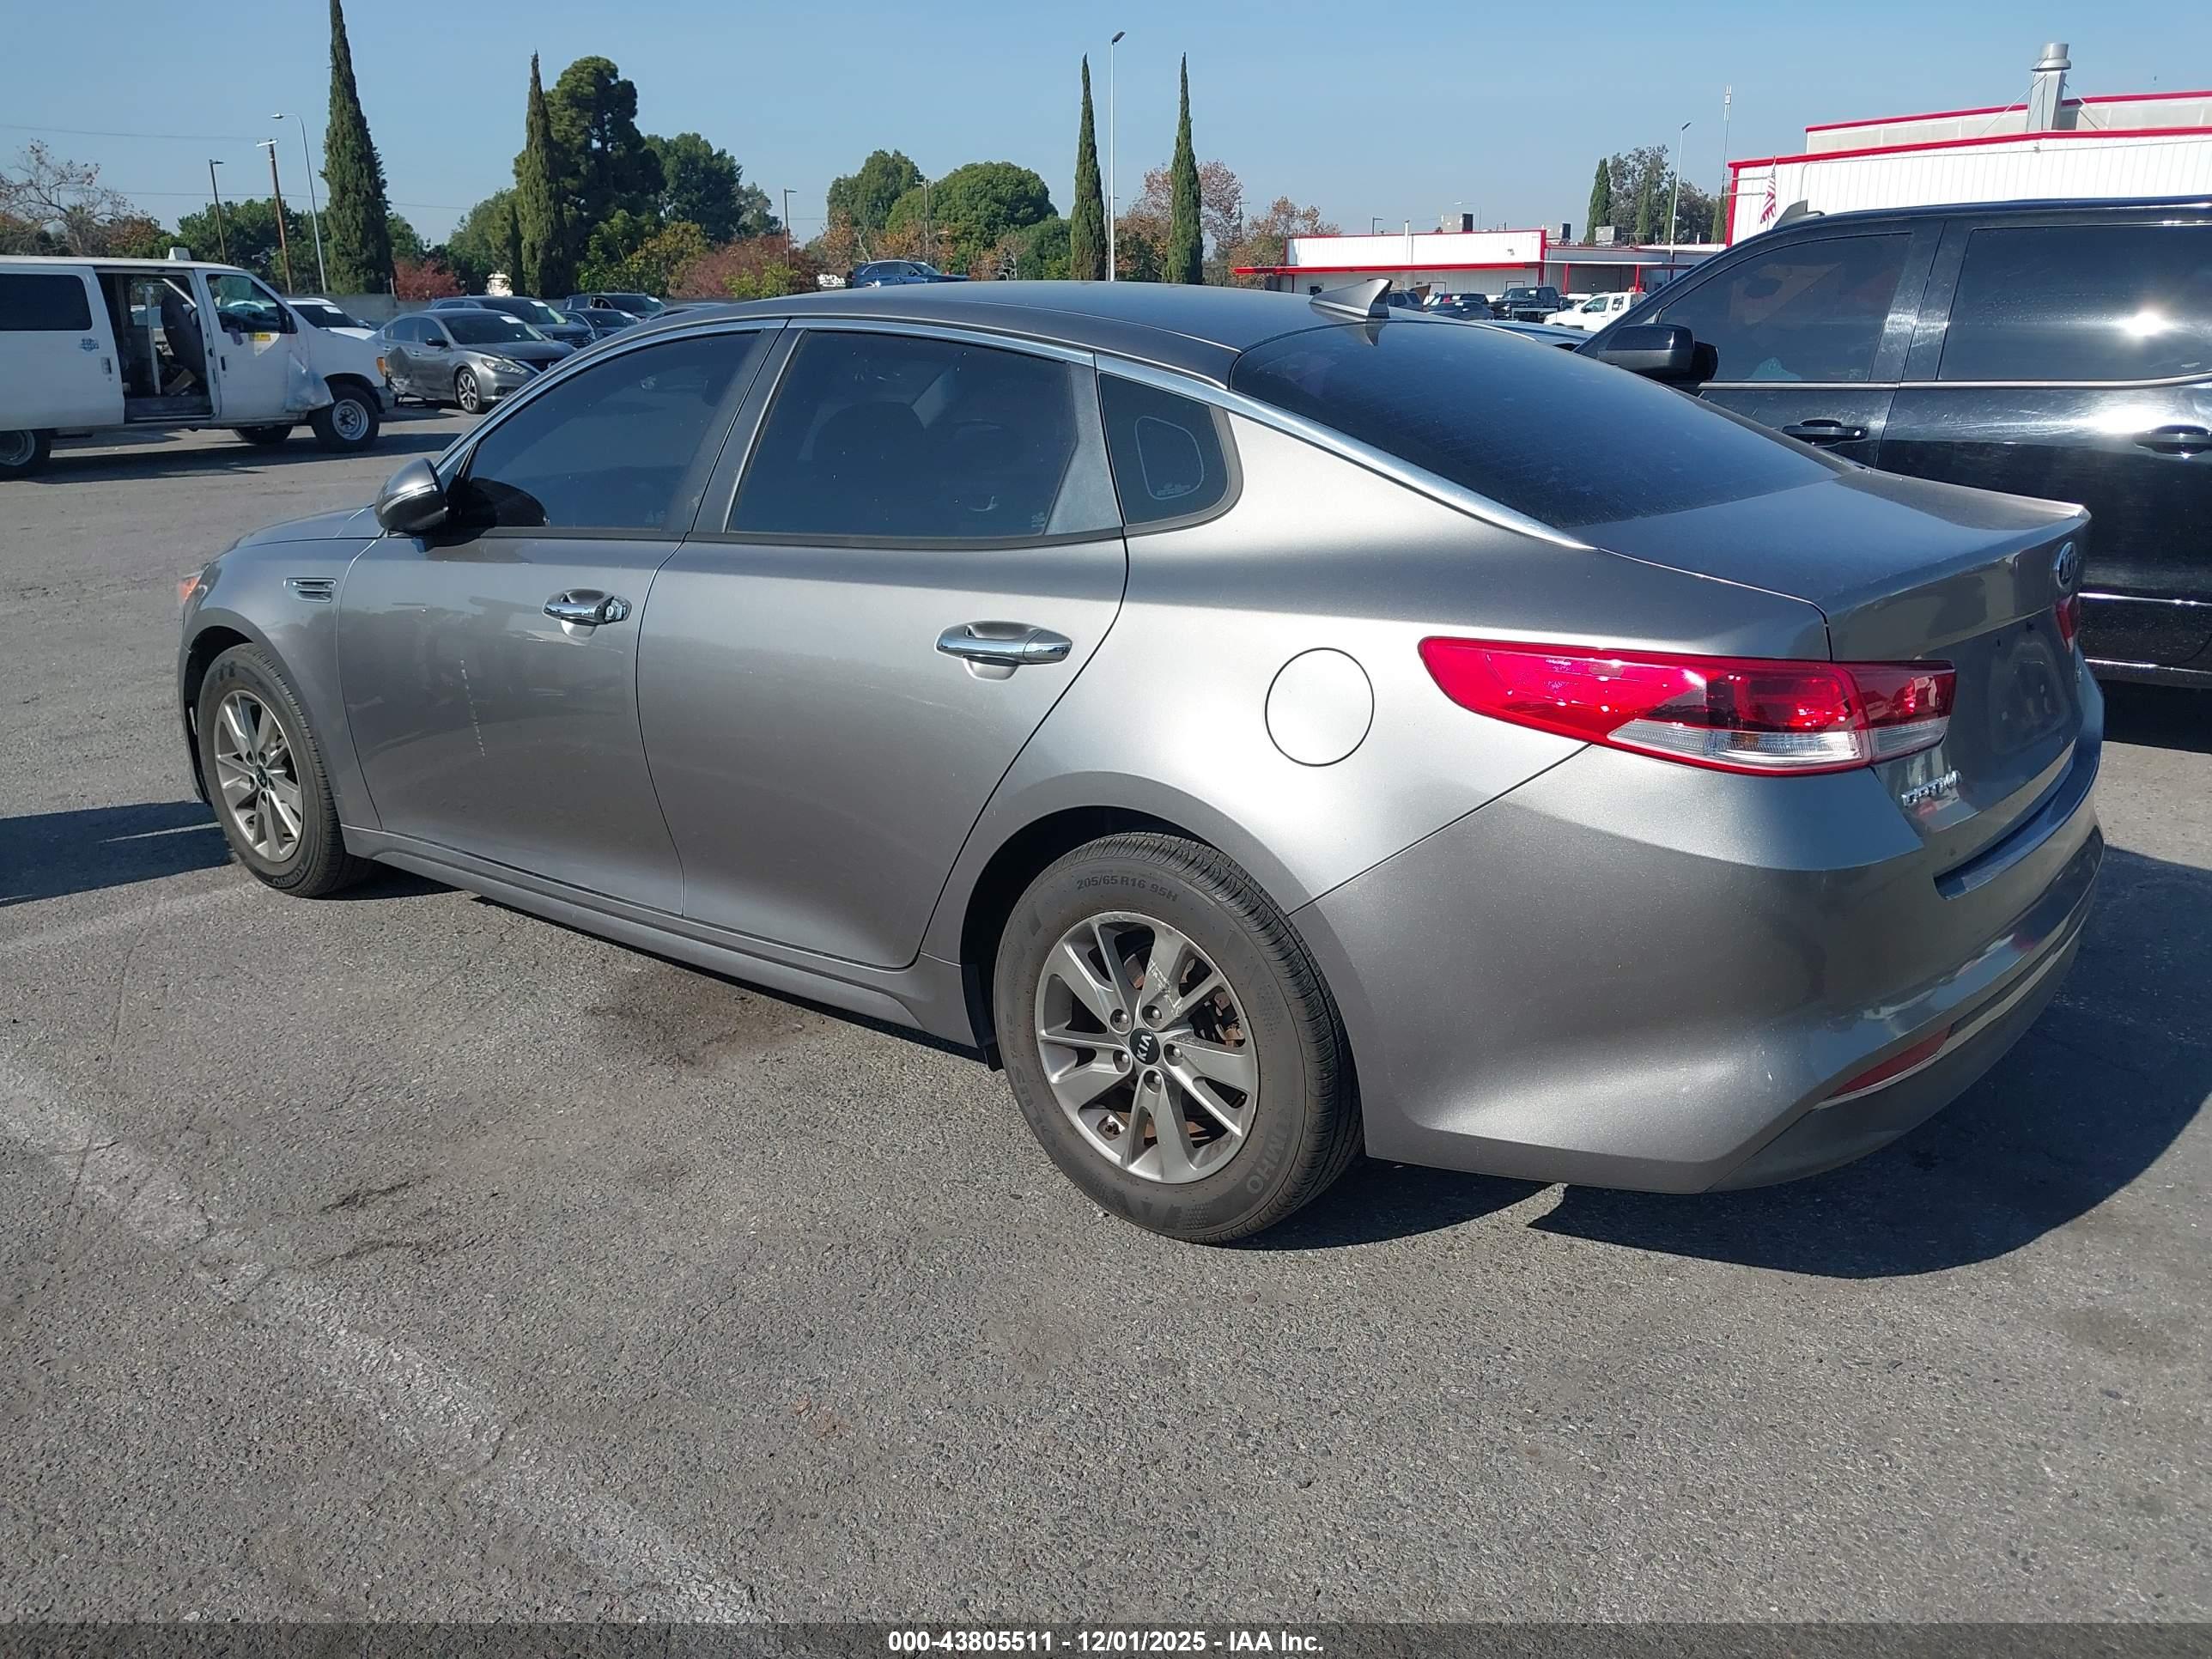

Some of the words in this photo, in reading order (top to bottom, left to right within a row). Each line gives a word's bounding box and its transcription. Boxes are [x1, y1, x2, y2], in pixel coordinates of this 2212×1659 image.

[1076, 875, 1118, 890] 205/65
[1120, 876, 1146, 889] R16
[1149, 883, 1179, 902] 95H
[1136, 1035, 1152, 1061] KIA
